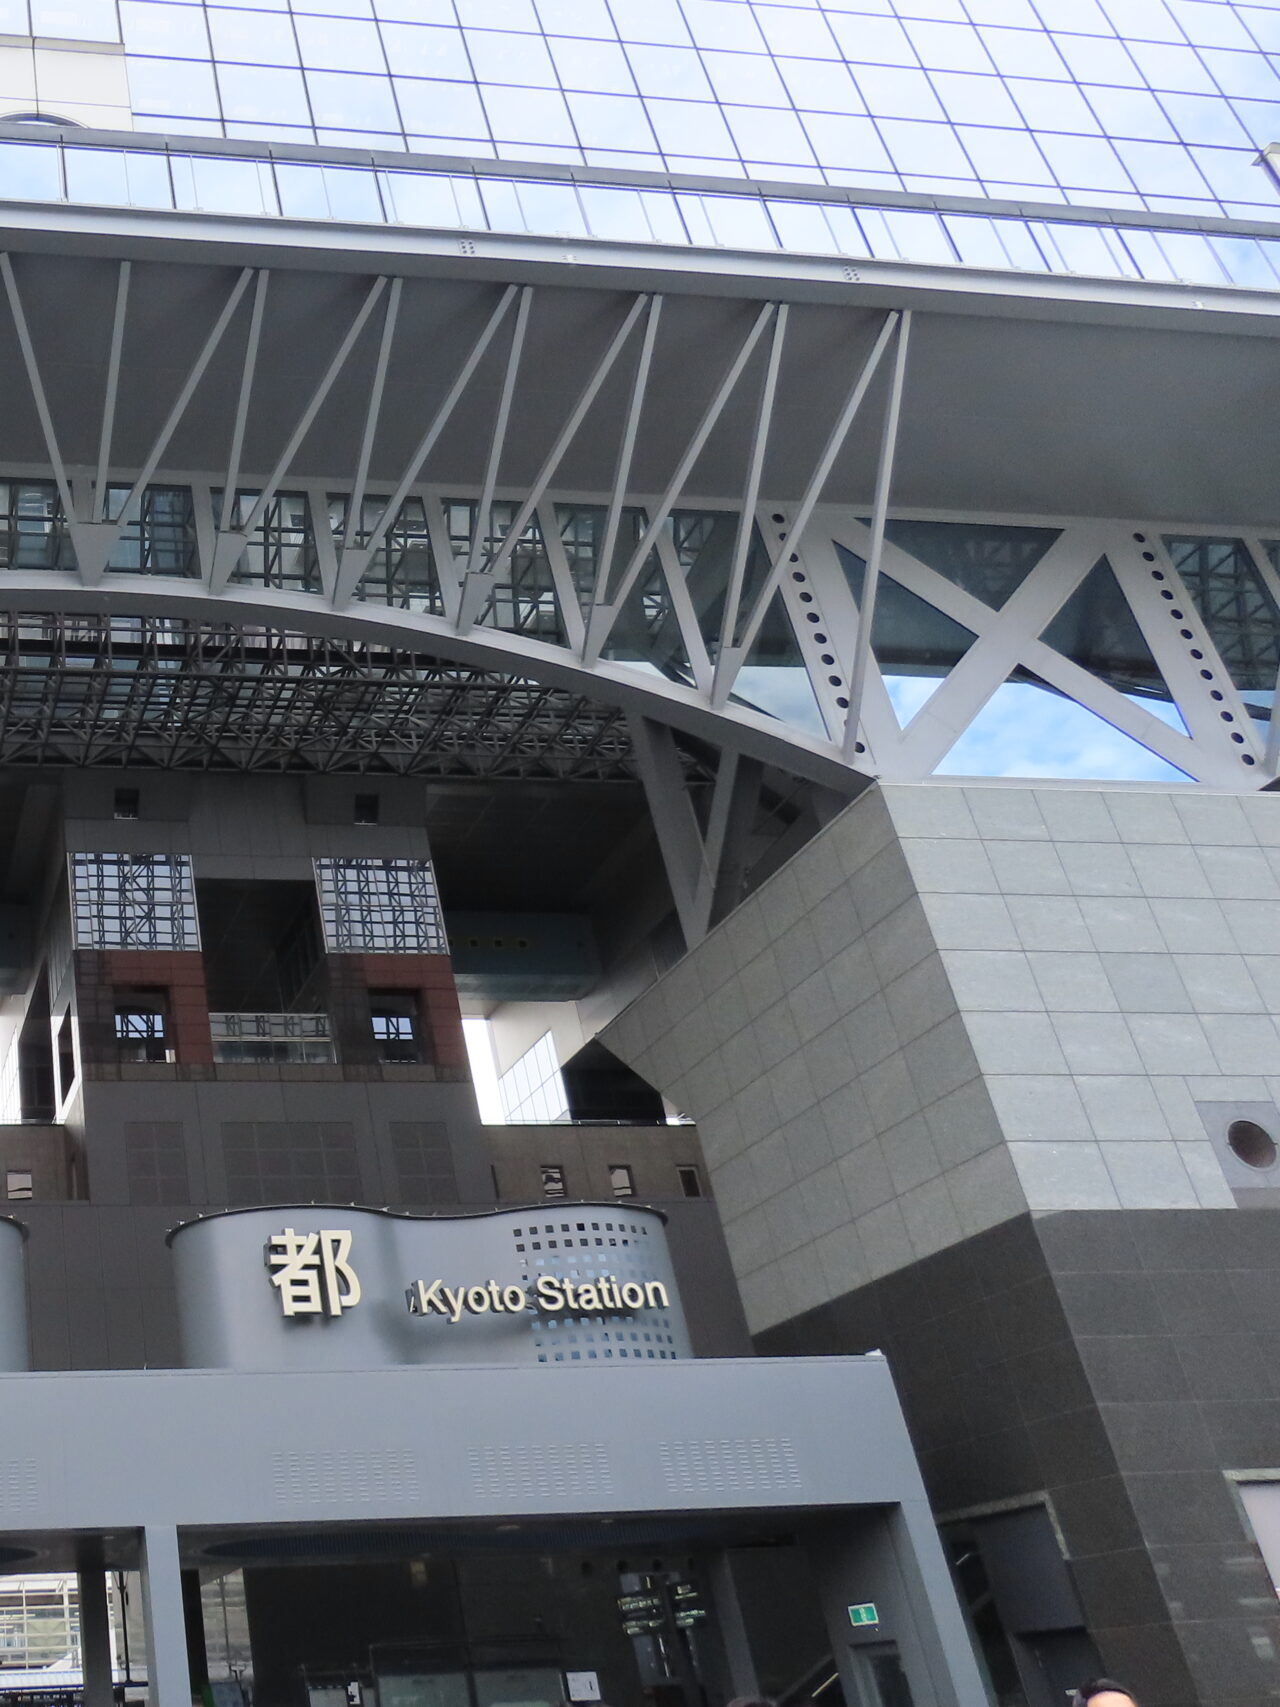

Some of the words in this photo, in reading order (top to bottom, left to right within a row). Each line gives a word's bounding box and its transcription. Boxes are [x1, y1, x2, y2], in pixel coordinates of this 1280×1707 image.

[268, 1228, 361, 1317] 都
[417, 1278, 526, 1324] Kyoto
[535, 1275, 670, 1312] Station
